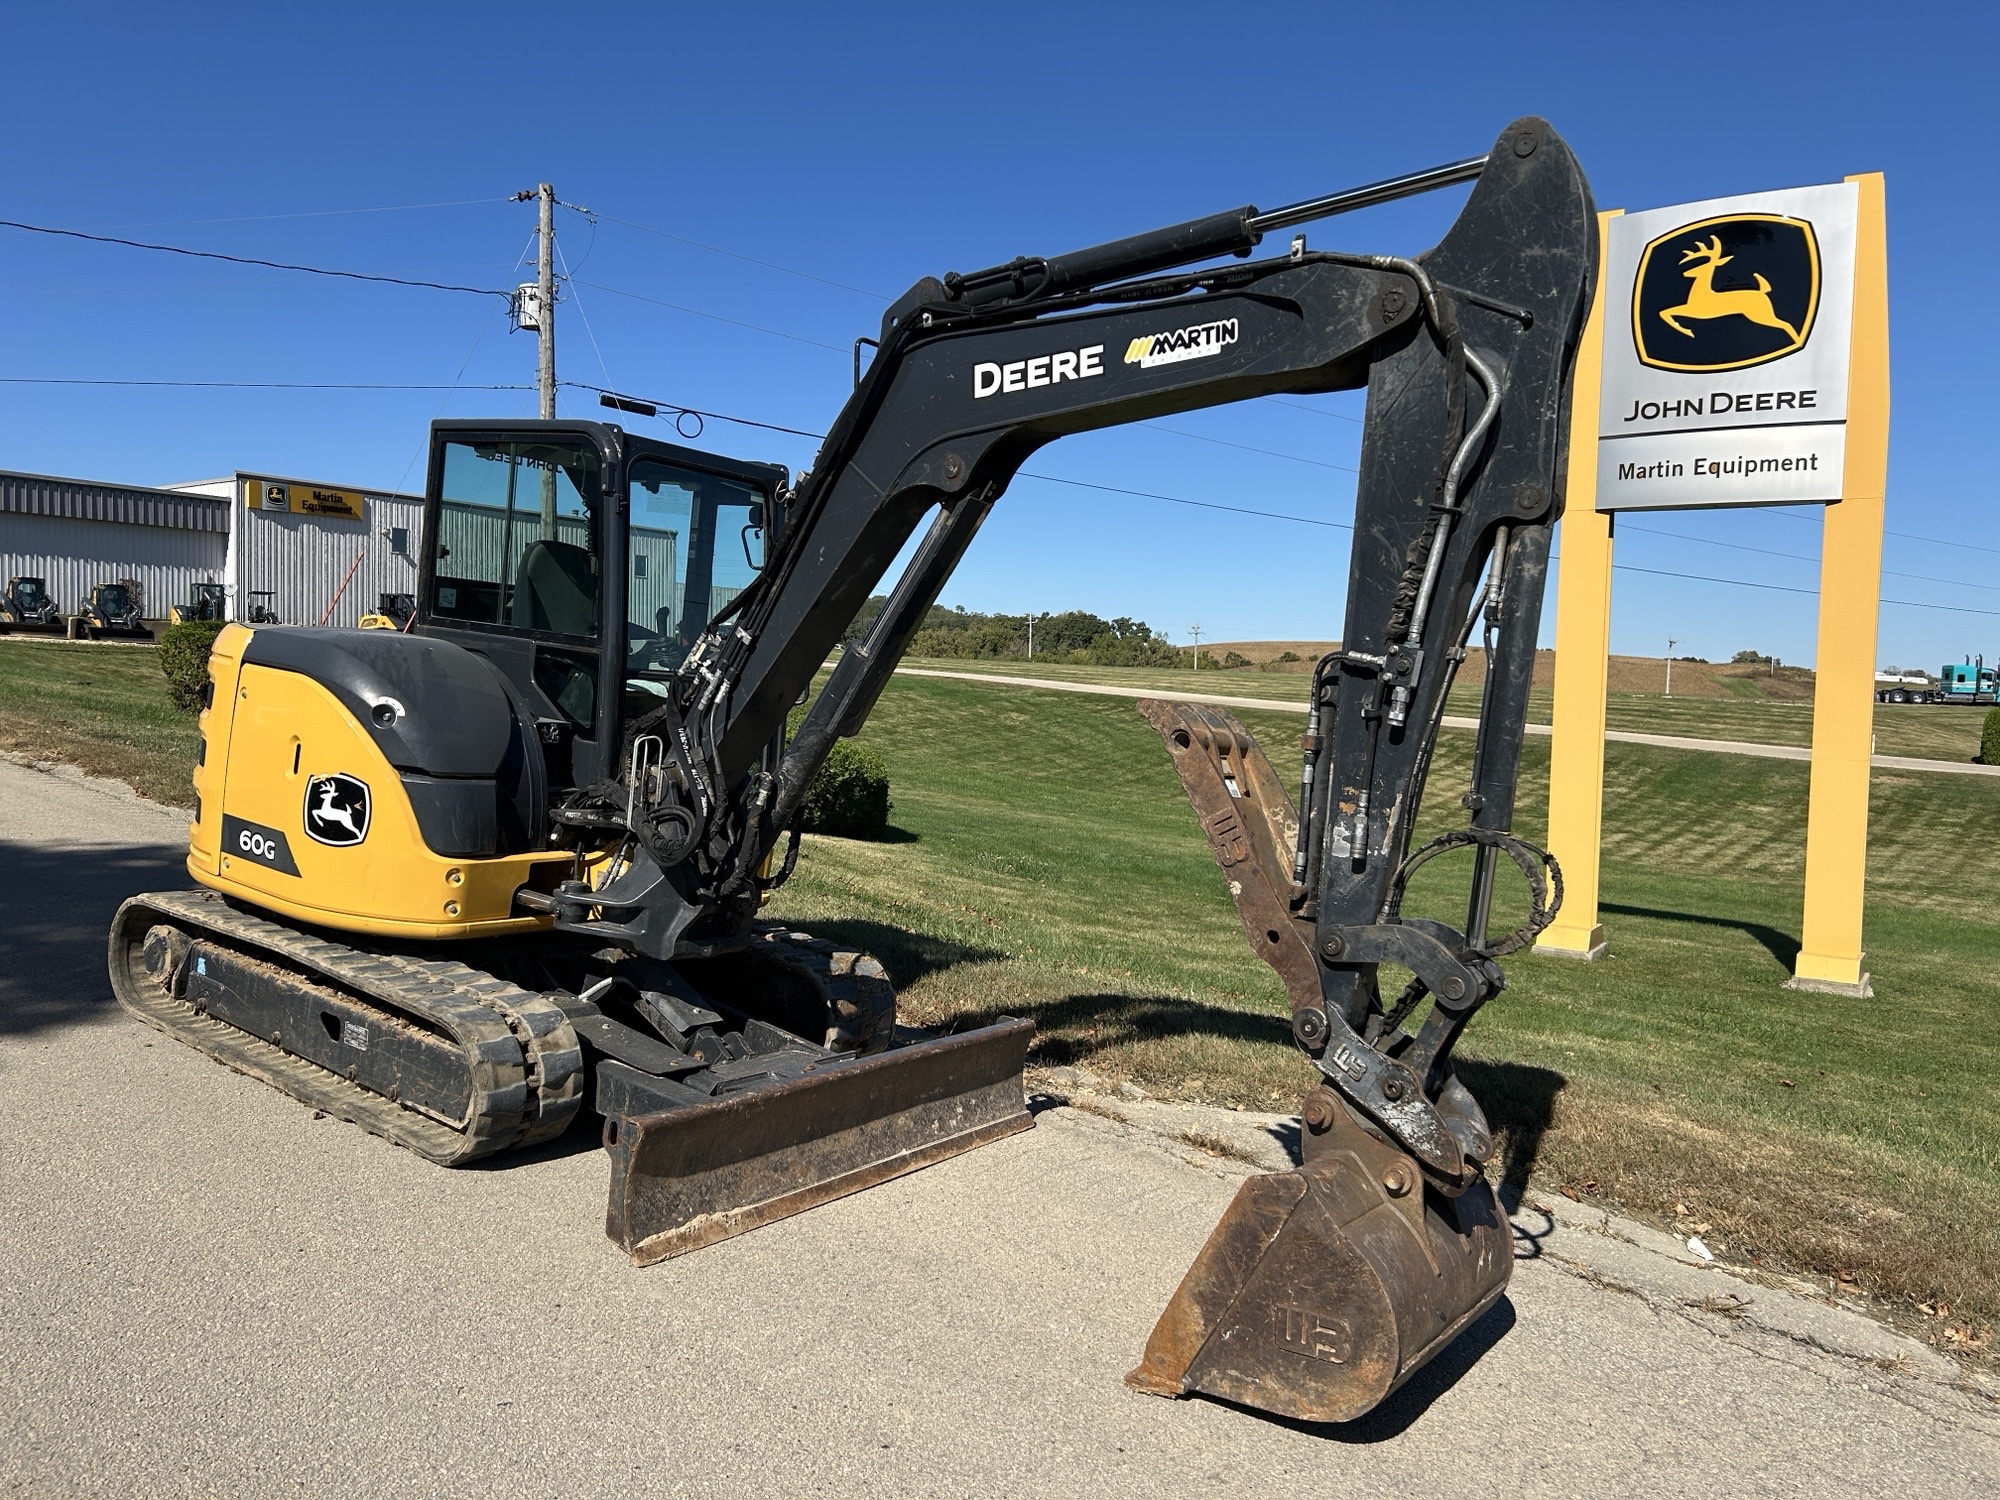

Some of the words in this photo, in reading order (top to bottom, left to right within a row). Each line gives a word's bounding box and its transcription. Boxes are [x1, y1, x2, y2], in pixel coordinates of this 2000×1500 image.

[1149, 321, 1236, 357] MARTIN
[974, 344, 1104, 399] DEERE
[1624, 398, 1703, 422] JOHN
[1710, 389, 1817, 414] DEERE
[1618, 460, 1683, 480] Martin
[1694, 453, 1818, 478] Equipment
[302, 500, 353, 515] Equipment
[313, 491, 343, 503] Martin
[239, 829, 276, 860] 60G
